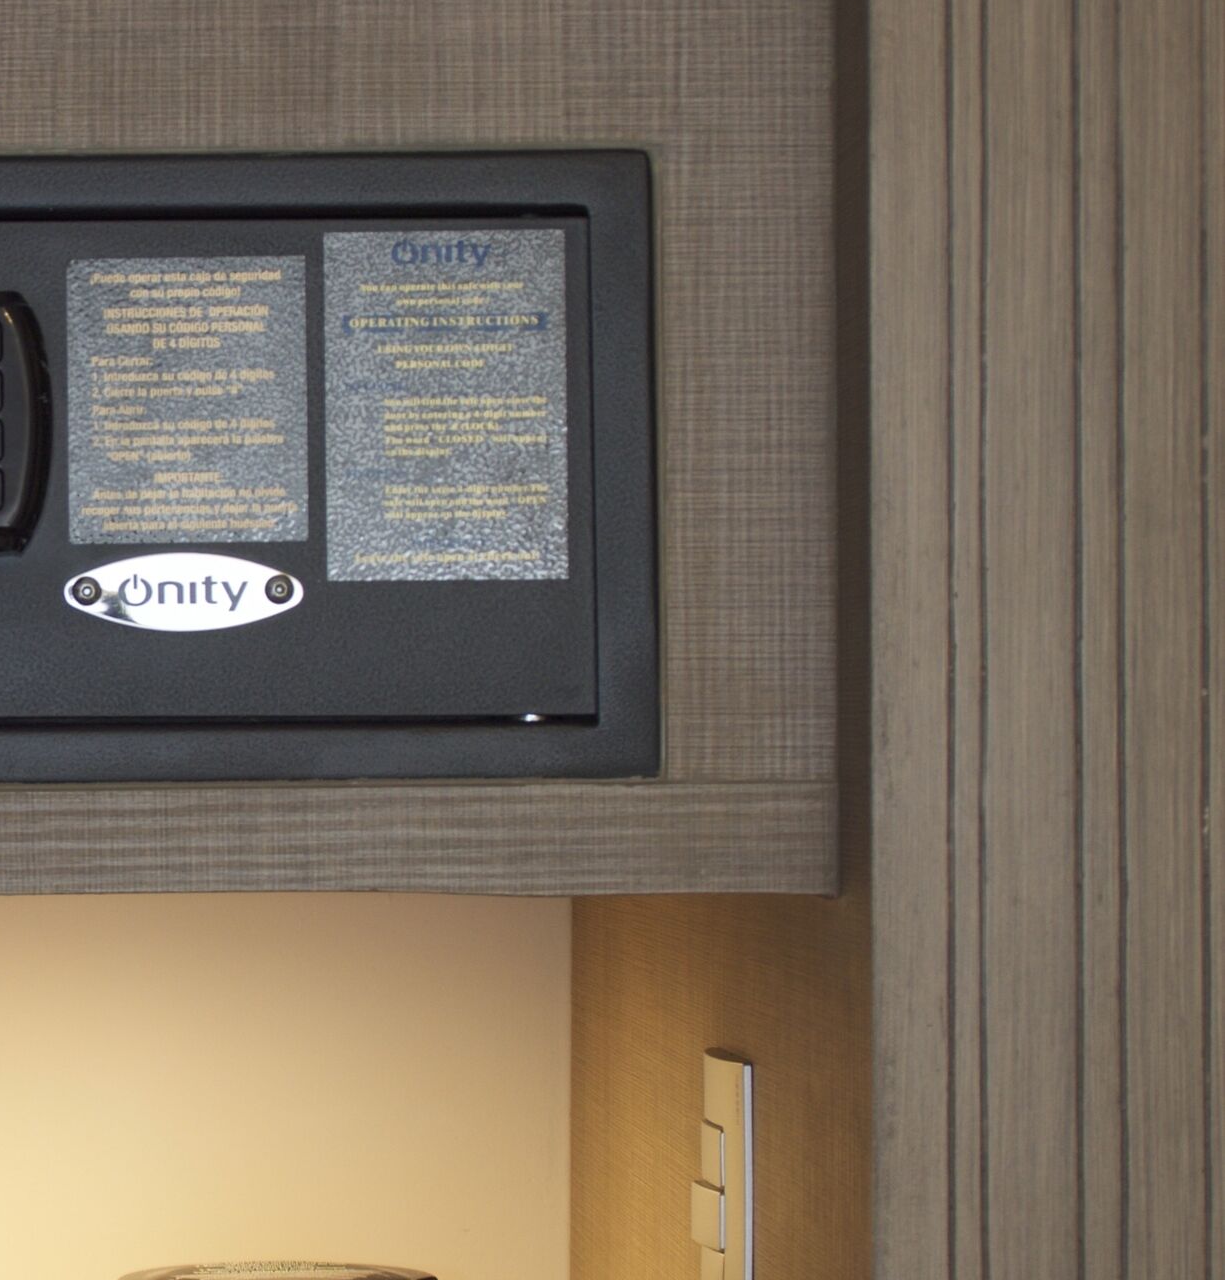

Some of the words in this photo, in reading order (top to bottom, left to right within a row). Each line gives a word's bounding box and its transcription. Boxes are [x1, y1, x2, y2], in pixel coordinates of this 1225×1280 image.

[391, 238, 492, 267] Onity
[128, 273, 161, 284] operar
[189, 271, 211, 283] caja
[229, 269, 282, 282] seguridad
[151, 289, 165, 298] su
[103, 306, 187, 320] INSTRUCCIONES
[189, 307, 204, 318] DE
[209, 304, 270, 318] OPERACIÓN
[106, 323, 150, 335] USANDO
[153, 323, 167, 334] SU
[169, 320, 208, 334] CÓDIGO
[210, 321, 266, 333] PERSONAL
[349, 314, 430, 328] OPERATING
[433, 314, 540, 328] INSTRUCTIONS
[153, 338, 167, 349] DE
[169, 338, 177, 349] 4
[179, 336, 221, 349] DÍGITOS
[118, 574, 248, 612] Onity
